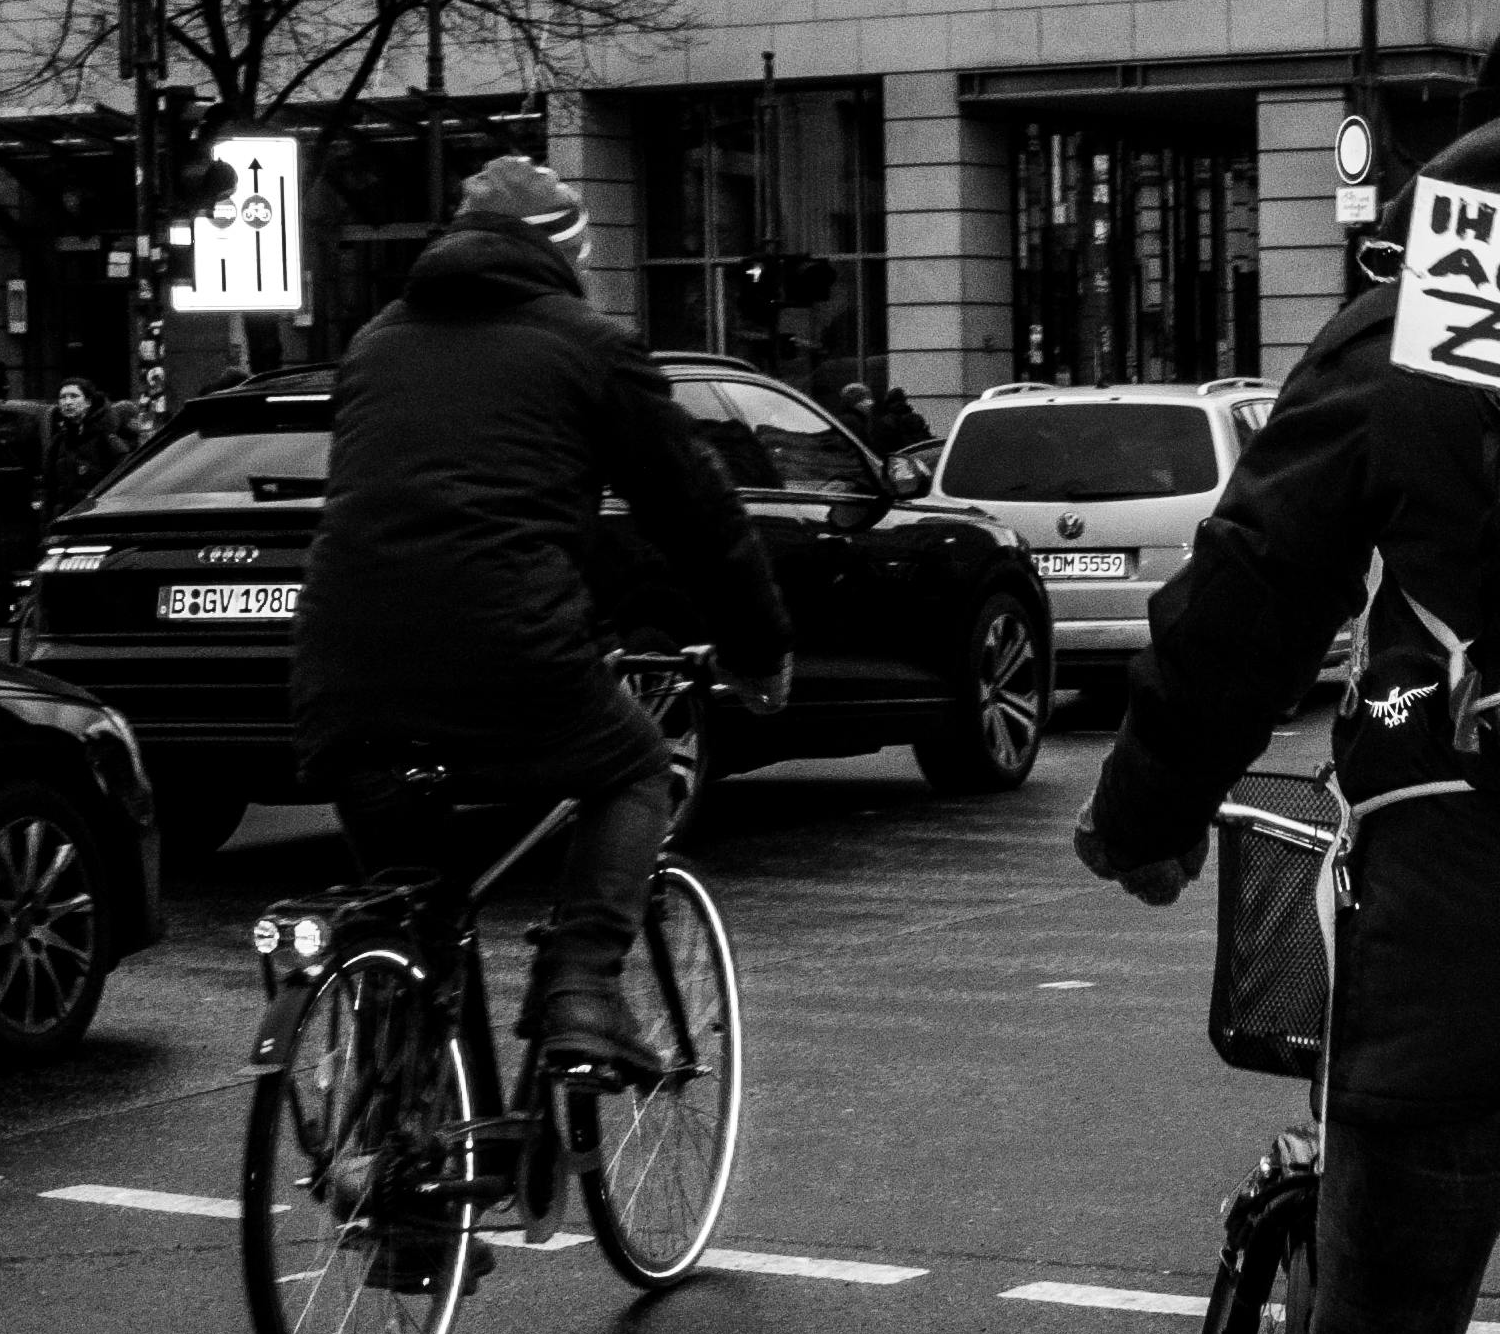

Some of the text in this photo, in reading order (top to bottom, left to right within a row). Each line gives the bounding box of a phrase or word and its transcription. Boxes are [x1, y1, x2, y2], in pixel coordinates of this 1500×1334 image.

[1078, 555, 1123, 573] 5559
[171, 589, 186, 614] B
[202, 588, 235, 614] GV
